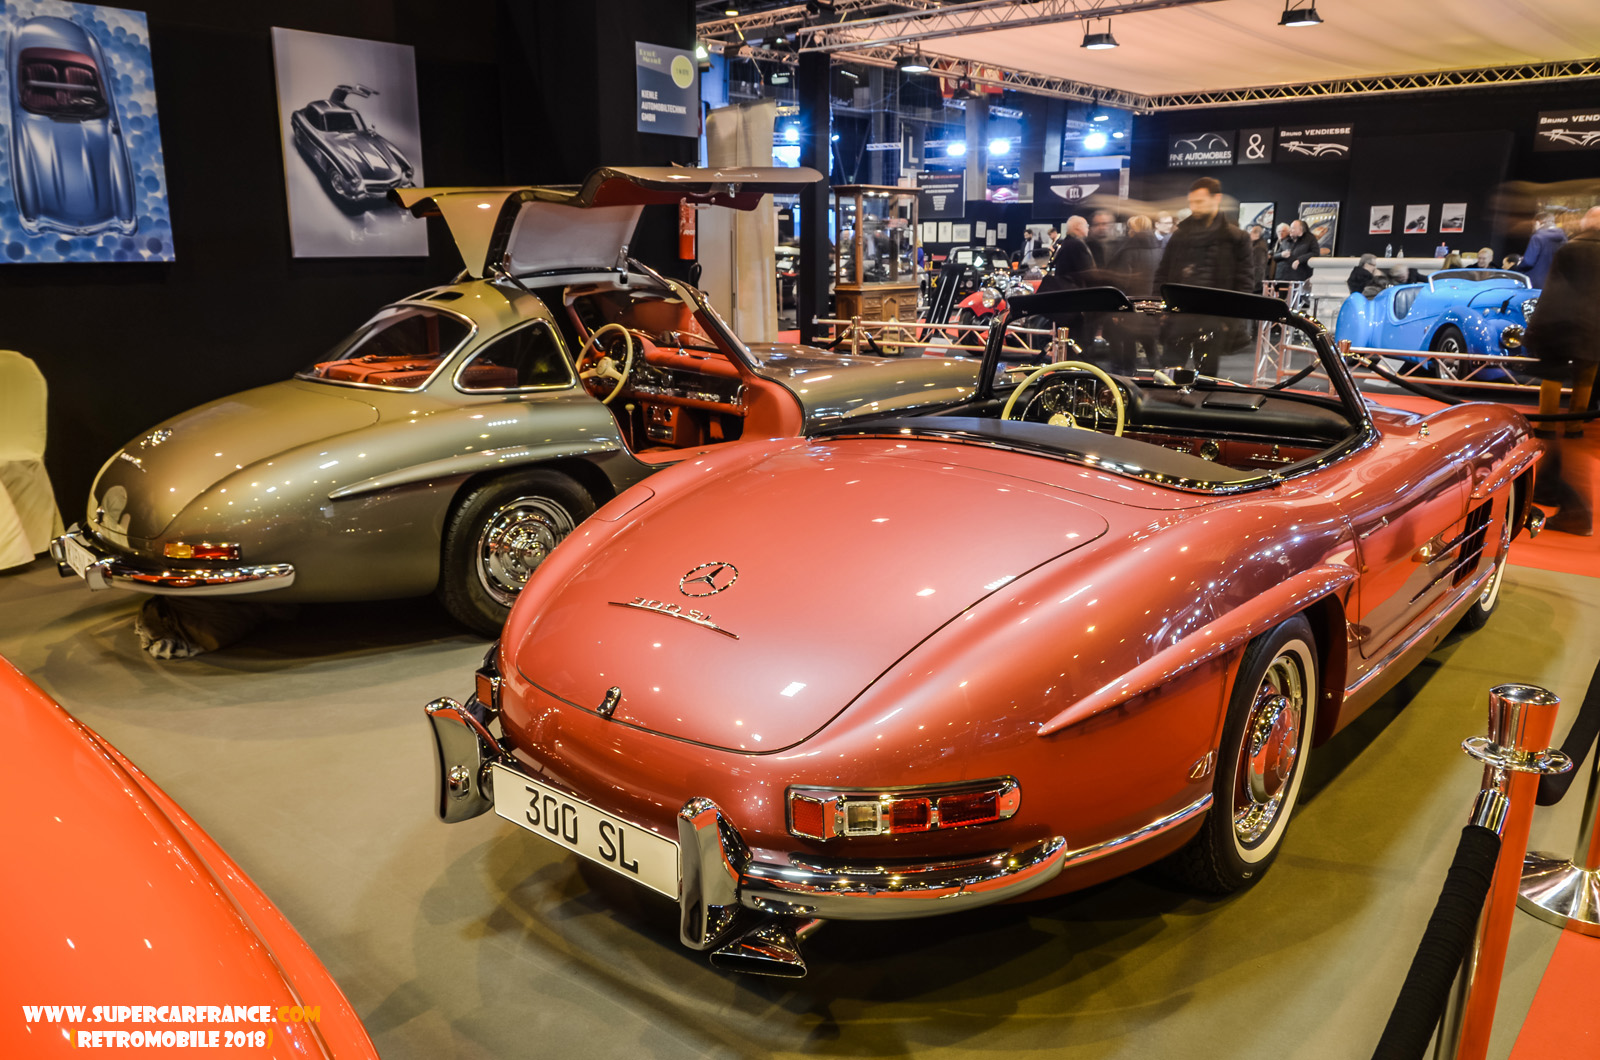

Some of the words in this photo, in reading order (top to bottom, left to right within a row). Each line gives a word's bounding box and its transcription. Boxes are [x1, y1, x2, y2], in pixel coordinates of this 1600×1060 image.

[641, 89, 658, 100] KIENLE
[641, 101, 687, 114] AUTOMOBILTECHNIK
[1304, 127, 1351, 136] VENDIESSE
[1245, 133, 1266, 160] &
[1184, 150, 1232, 160] AUTOMOBILES
[525, 785, 578, 845] 300
[598, 819, 639, 875] SL
